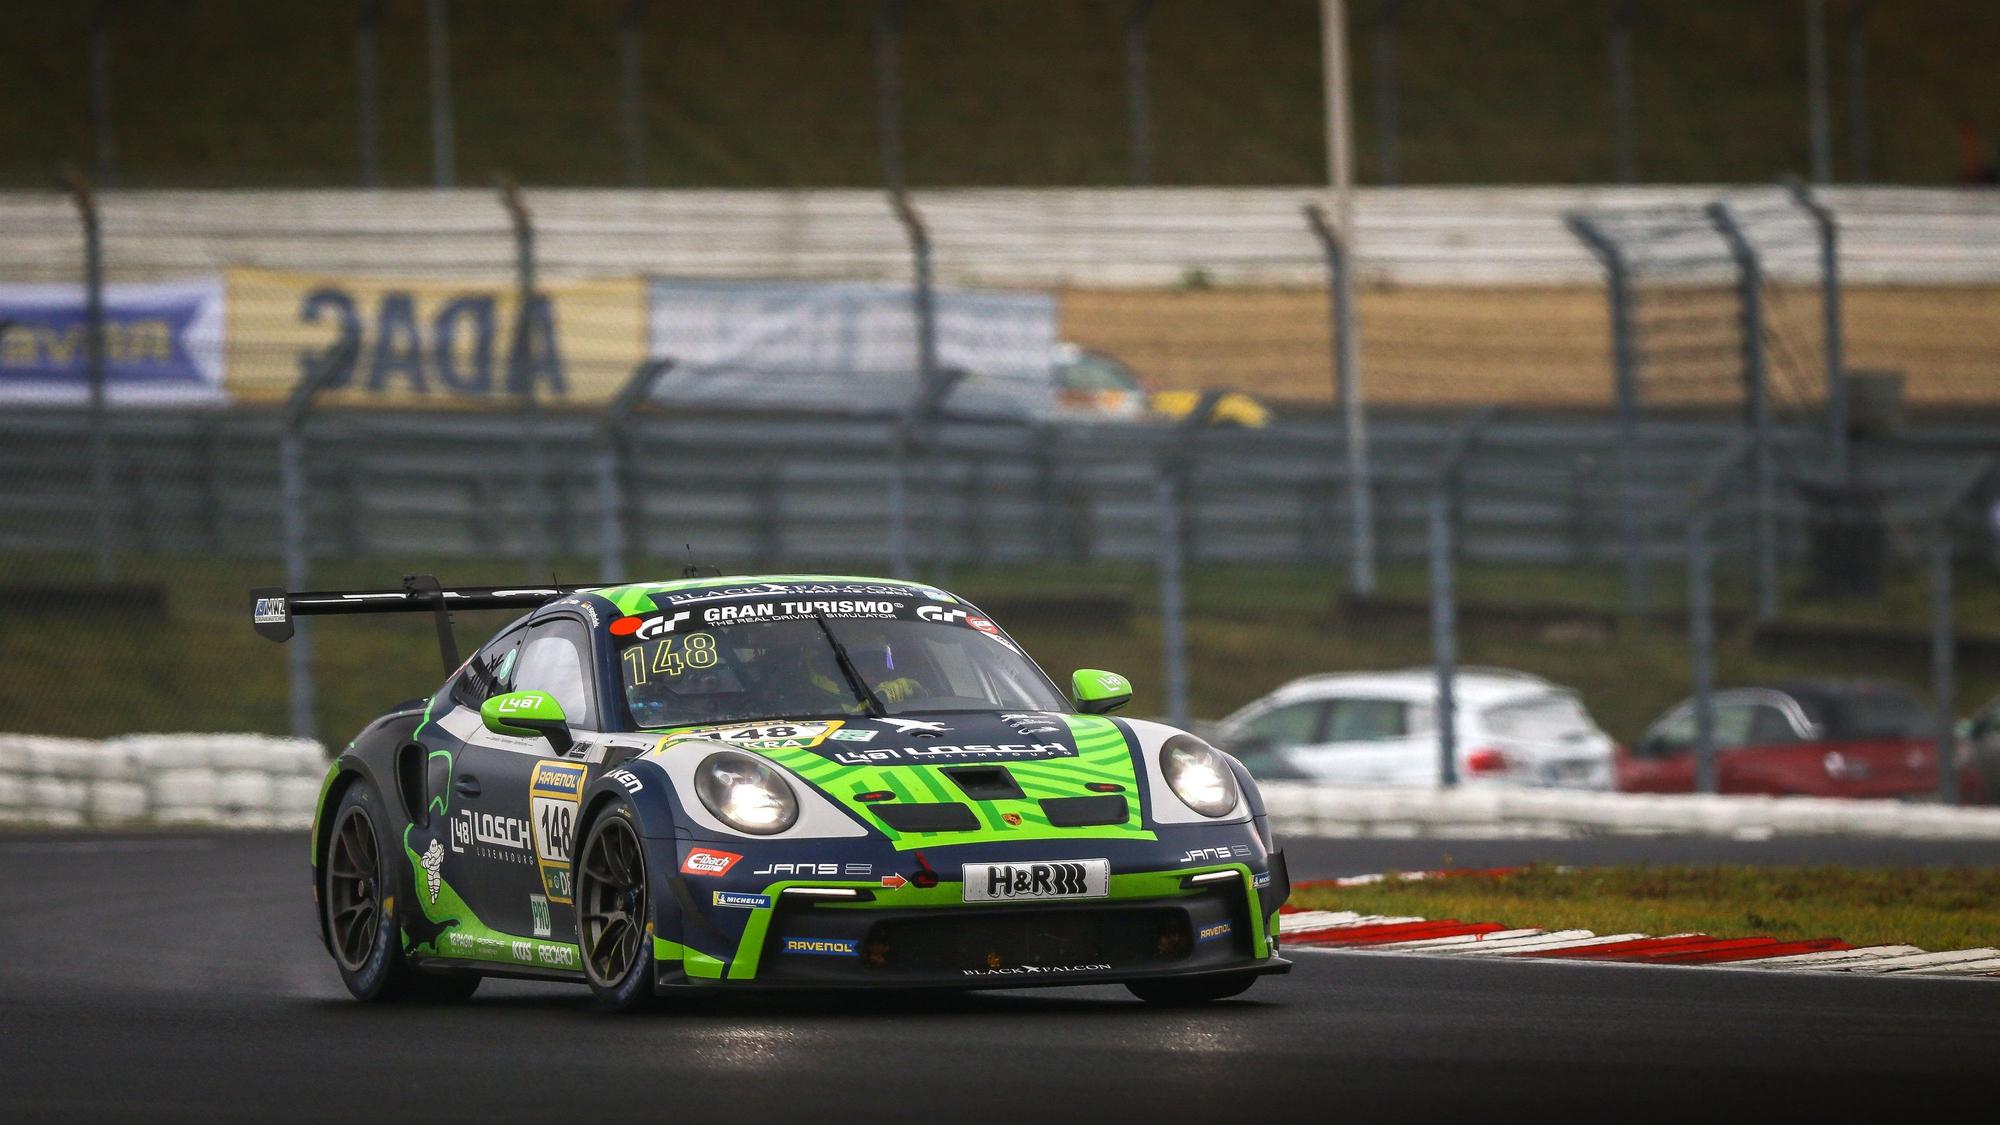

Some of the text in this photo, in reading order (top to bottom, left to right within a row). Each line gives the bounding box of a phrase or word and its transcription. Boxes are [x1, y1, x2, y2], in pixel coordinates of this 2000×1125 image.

[704, 604, 773, 622] GRAN
[708, 619, 735, 627] THE
[737, 616, 771, 624] REAL
[623, 632, 718, 686] 148
[699, 726, 797, 740] 148
[904, 743, 1068, 756] LOSCH
[538, 771, 577, 788] RAVENOL
[474, 812, 532, 850] LOSCH
[542, 804, 574, 858] 148
[476, 846, 535, 865] LUXEMBOURG
[688, 853, 729, 872] Eibach
[1180, 846, 1232, 862] JANS
[753, 863, 839, 875] JANS
[726, 896, 766, 905] MICHELIN
[1200, 923, 1233, 940] RAVENOL
[538, 944, 574, 966] RECARO
[787, 940, 853, 953] RAVENOL
[962, 963, 1112, 976] BLACK FALCON
